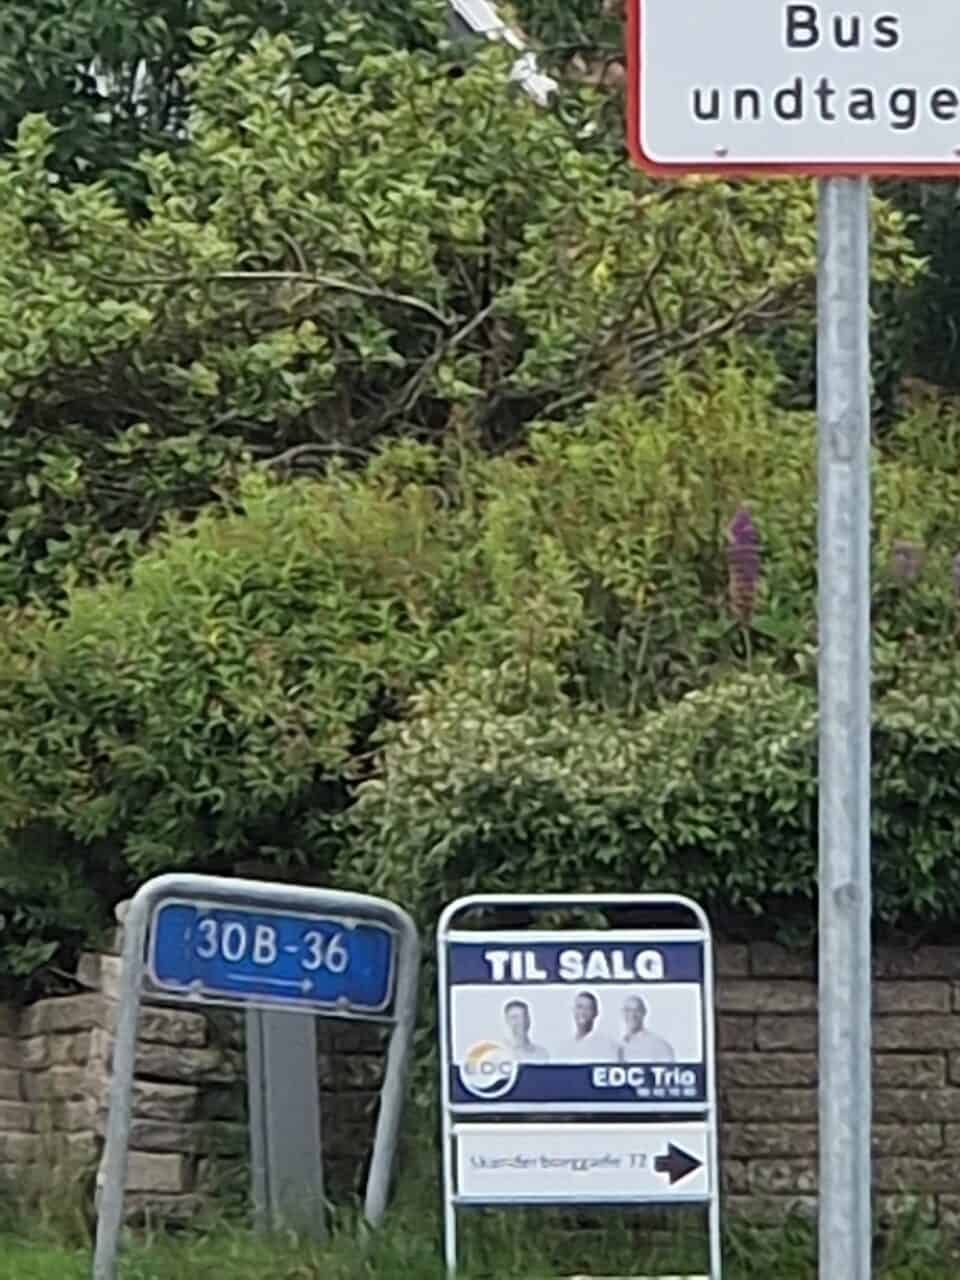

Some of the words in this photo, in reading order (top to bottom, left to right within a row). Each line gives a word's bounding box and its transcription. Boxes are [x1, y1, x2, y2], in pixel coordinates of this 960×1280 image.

[785, 4, 901, 48] Bus
[485, 950, 547, 981] TIL
[559, 949, 664, 980] SALG
[592, 1068, 645, 1087] EDC
[651, 1068, 696, 1086] Trio
